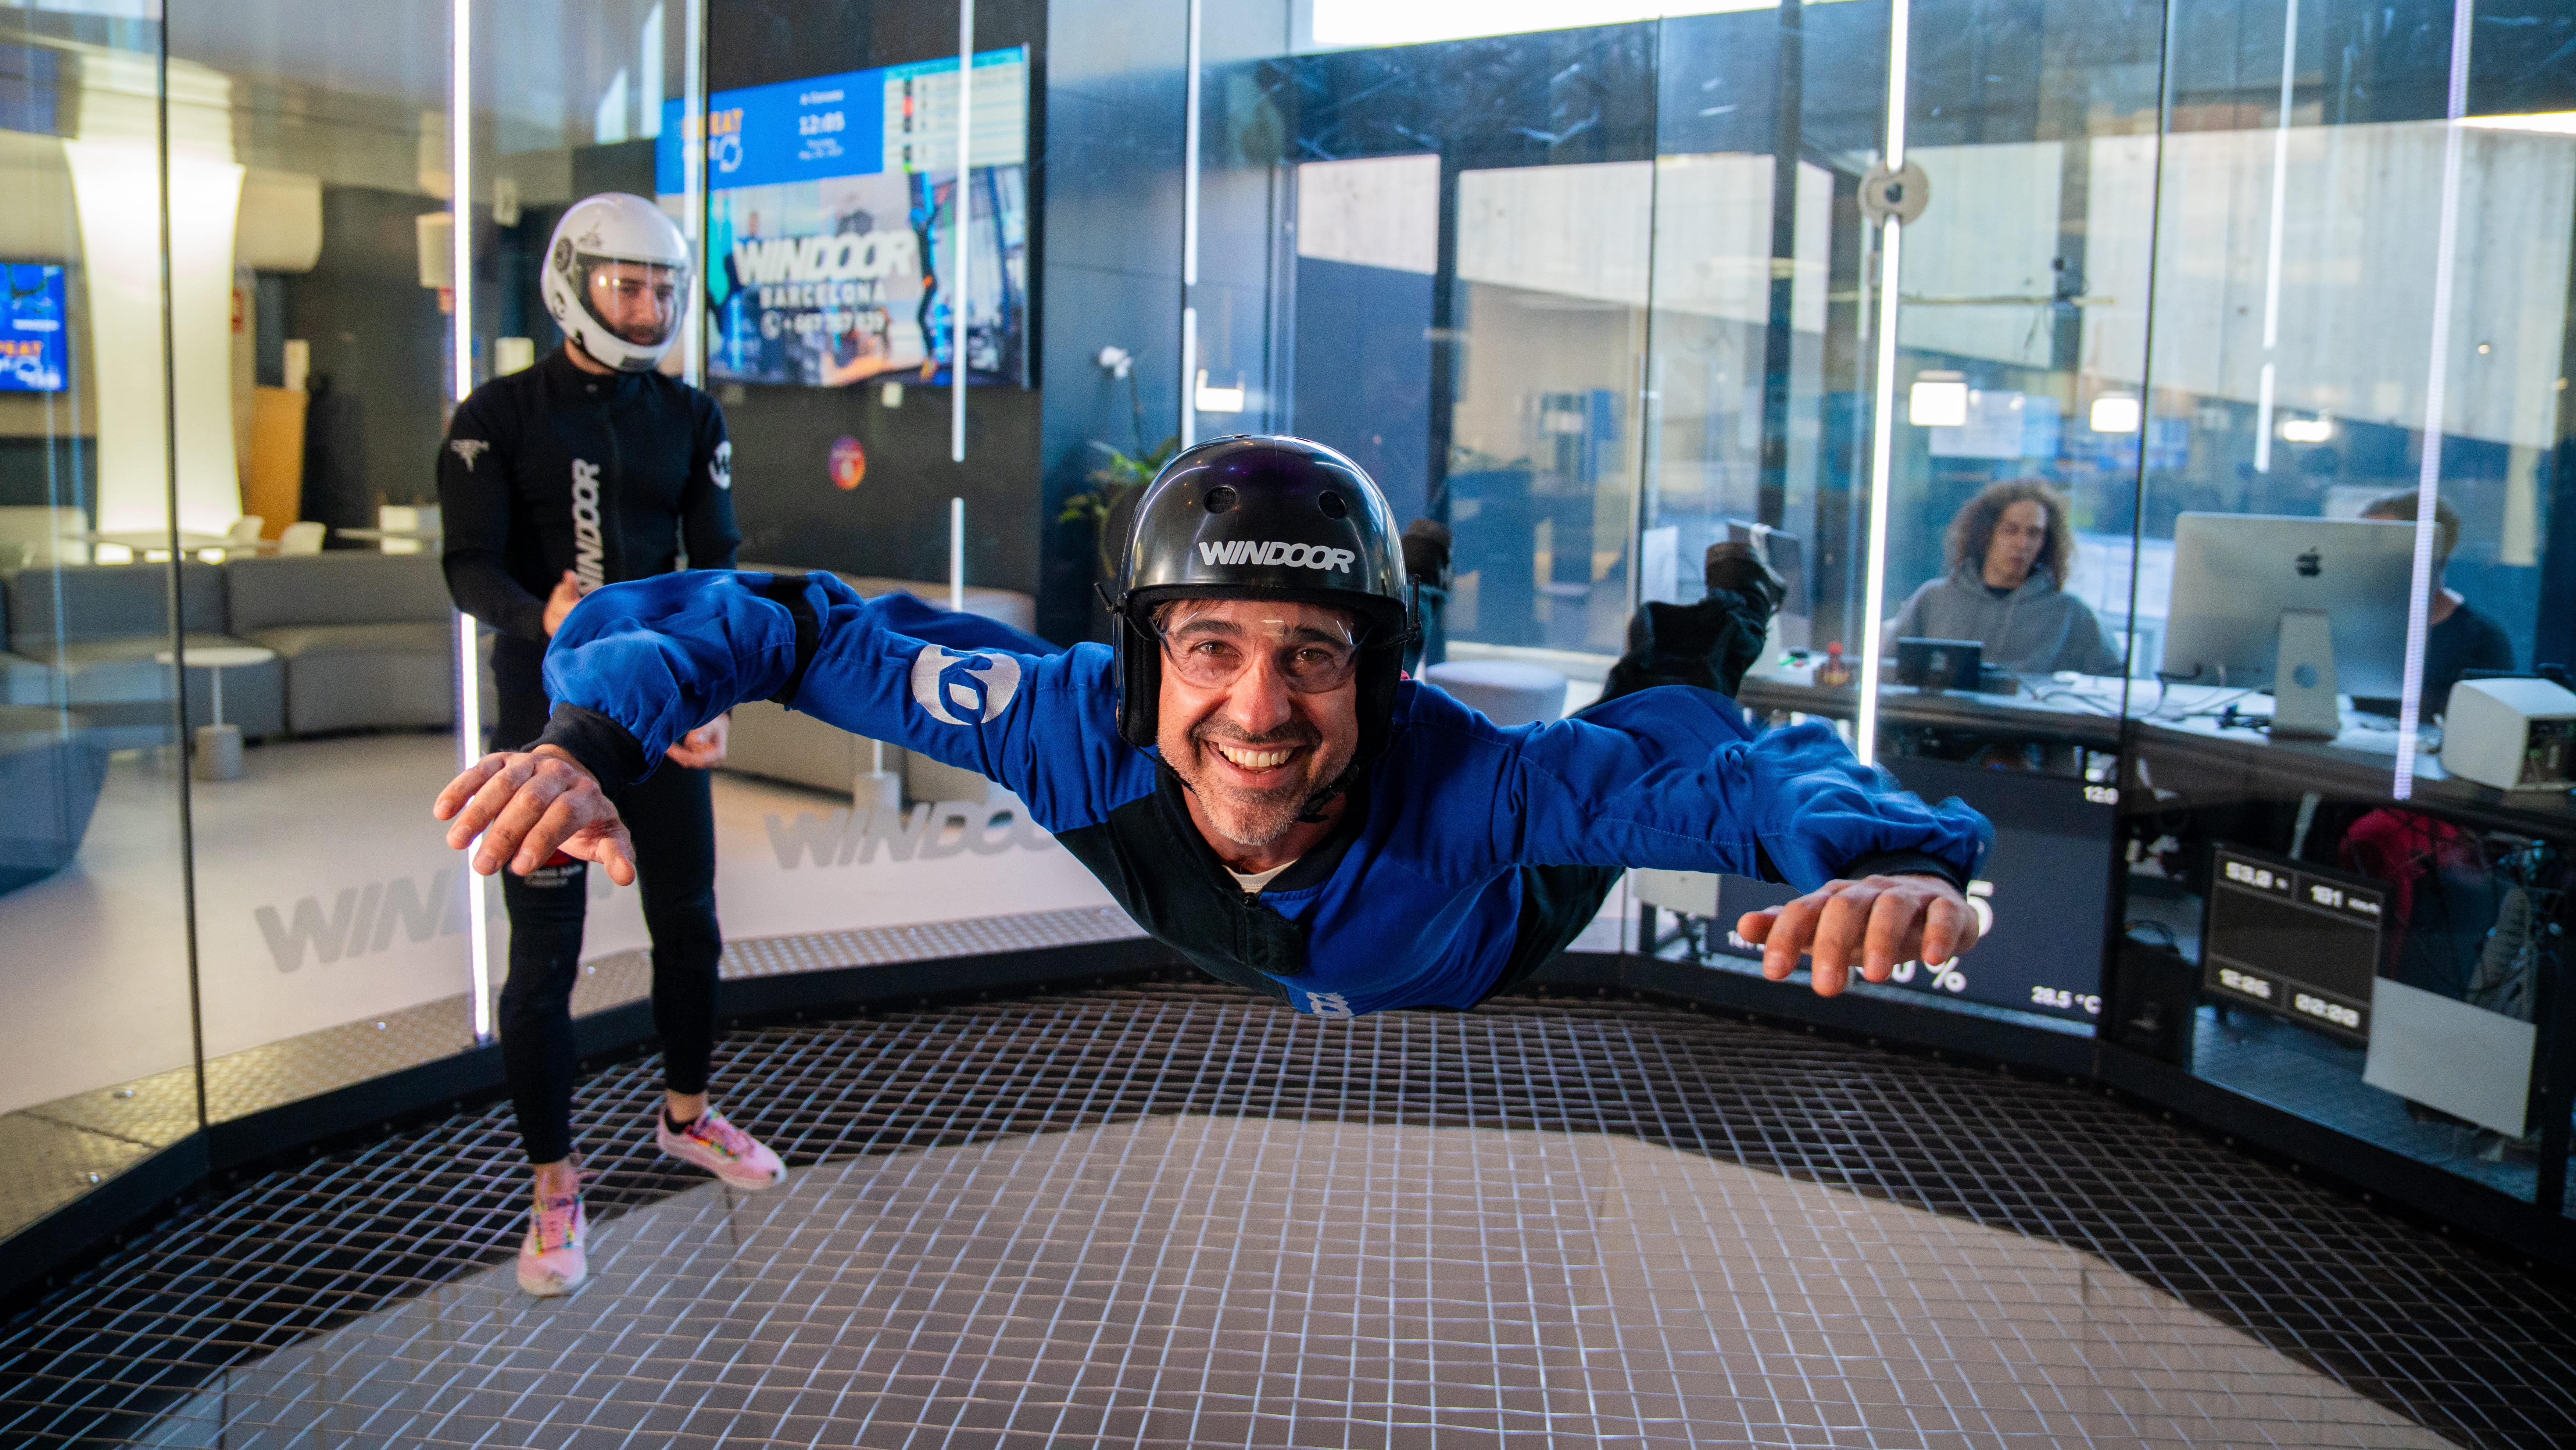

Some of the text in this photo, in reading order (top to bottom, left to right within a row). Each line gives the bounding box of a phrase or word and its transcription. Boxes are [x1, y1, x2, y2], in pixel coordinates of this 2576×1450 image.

[734, 230, 917, 286] WINDOOR
[759, 281, 886, 308] BARCELONA
[1199, 541, 1355, 574] WINDOOR
